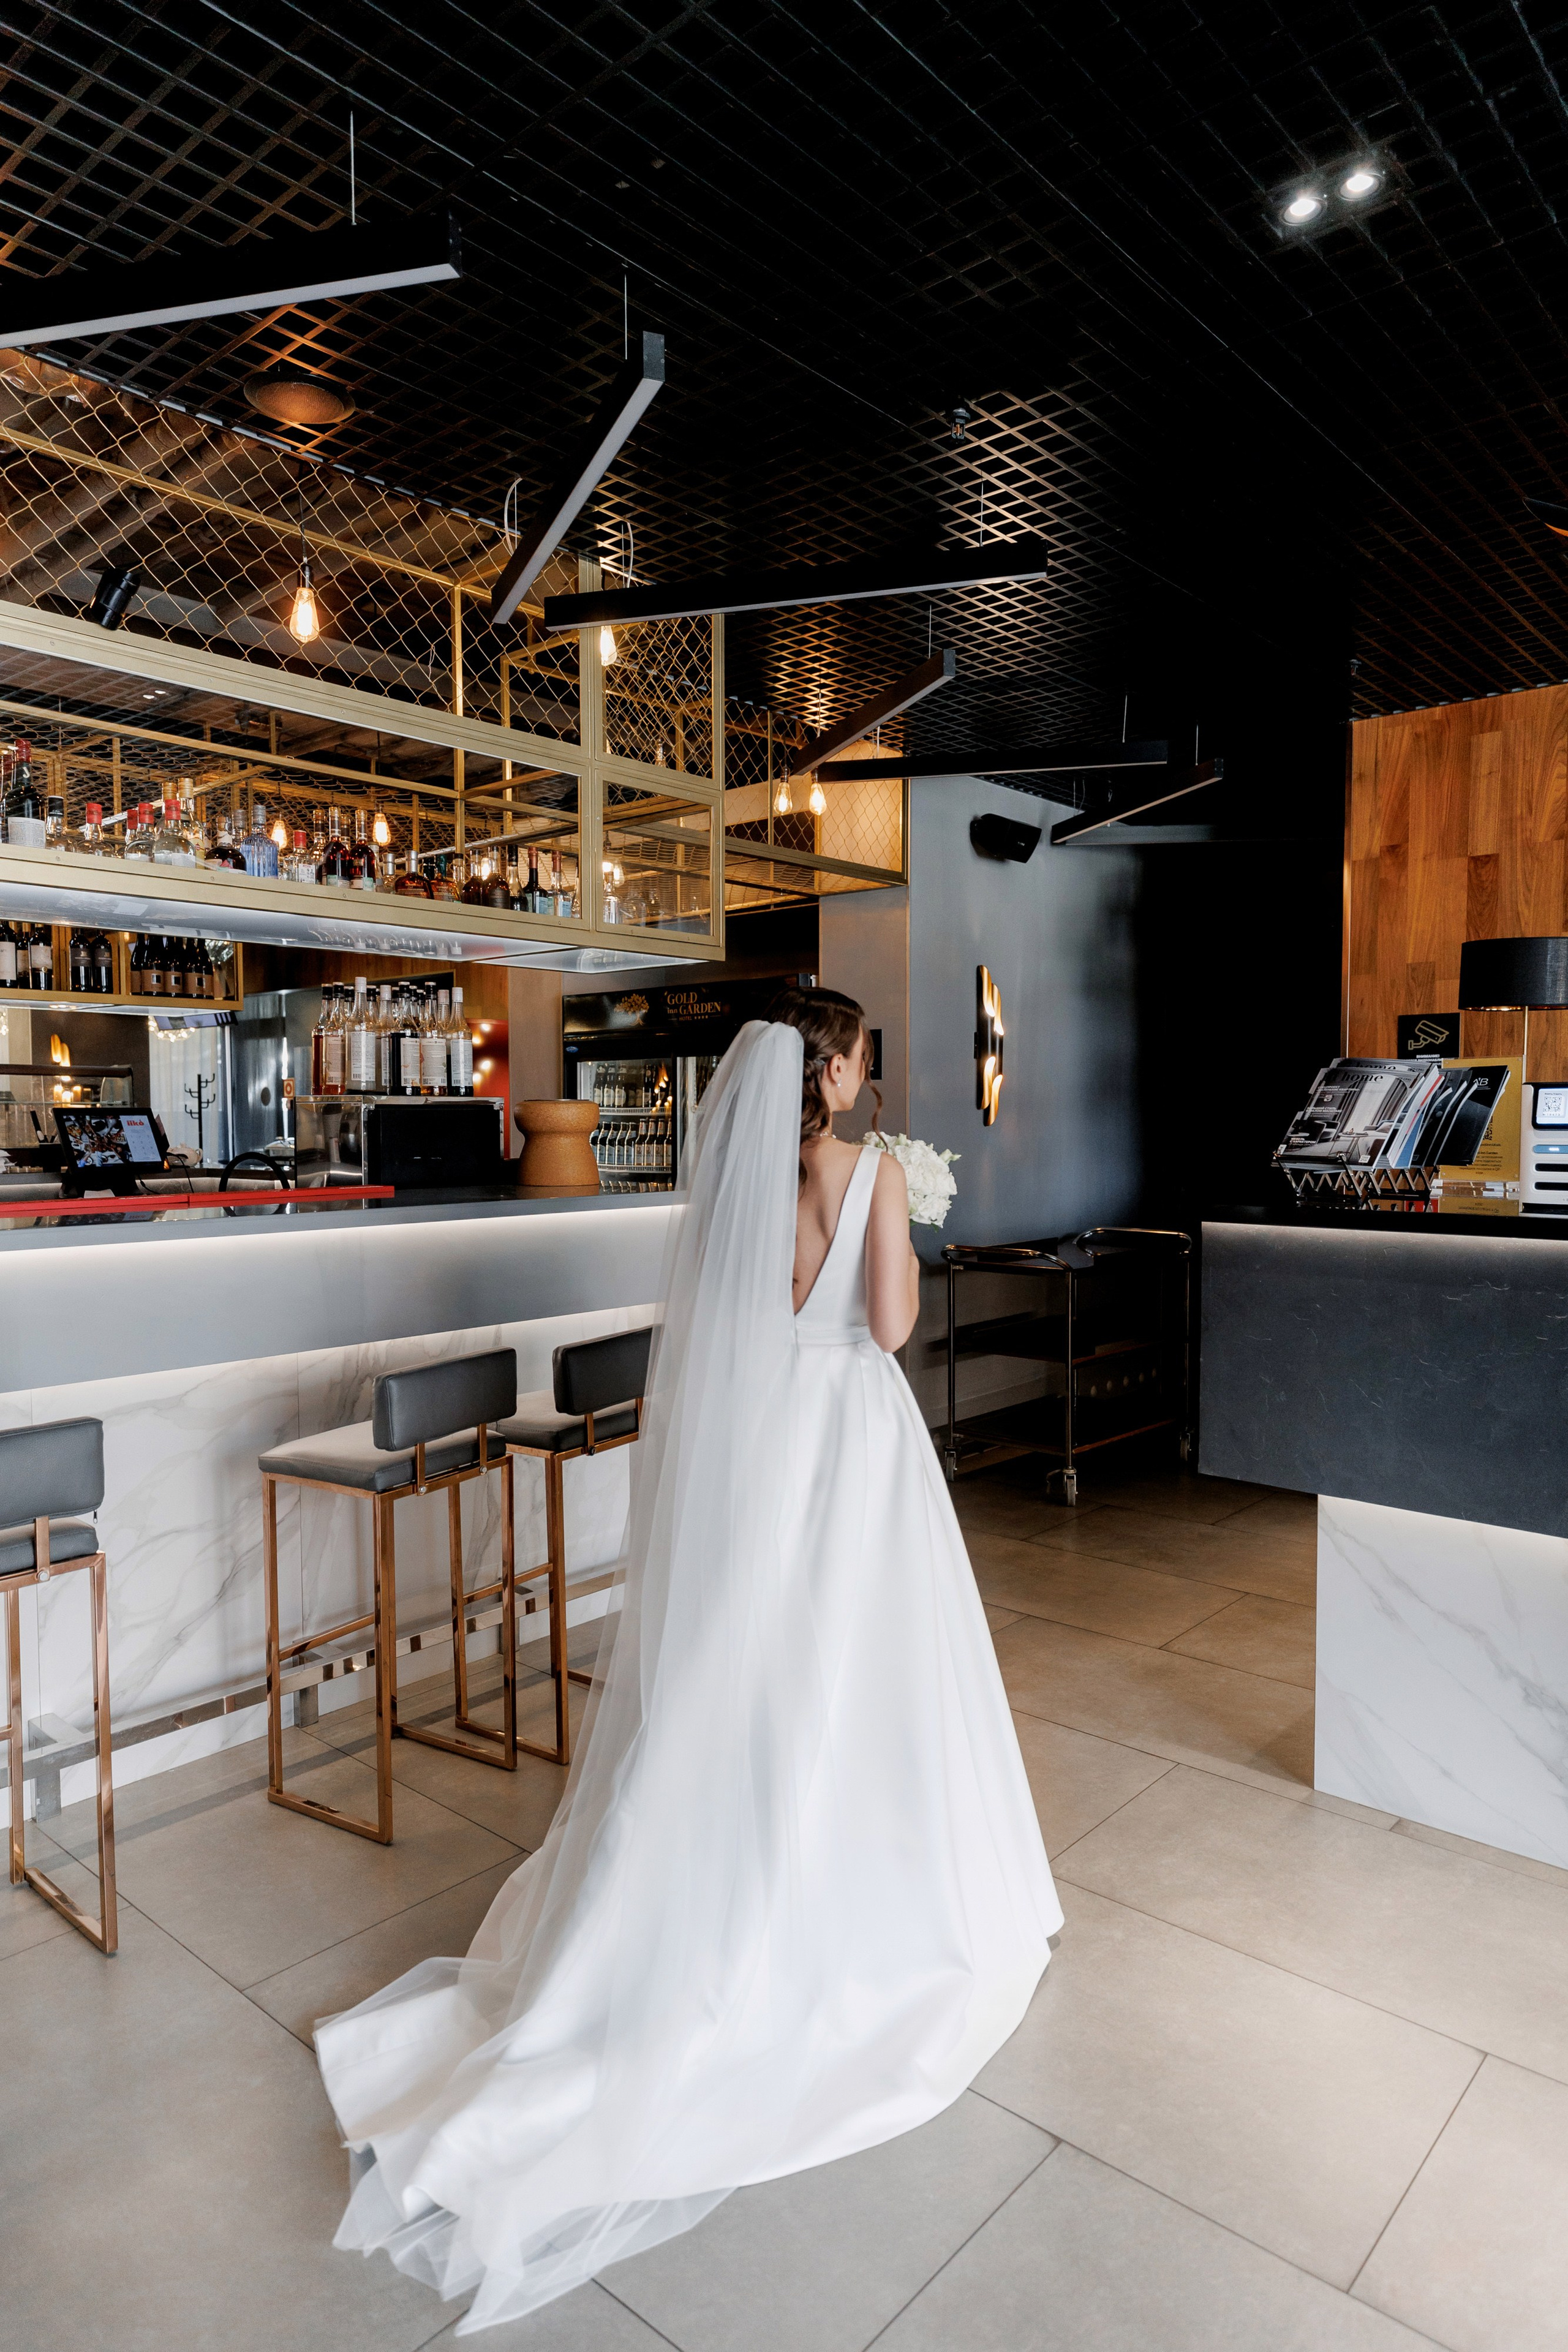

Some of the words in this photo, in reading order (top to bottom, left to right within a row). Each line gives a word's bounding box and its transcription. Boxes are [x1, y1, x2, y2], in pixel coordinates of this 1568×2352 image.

[667, 992, 698, 1005] GOLD
[679, 1001, 721, 1015] GARDEN
[1341, 1071, 1383, 1082] home
